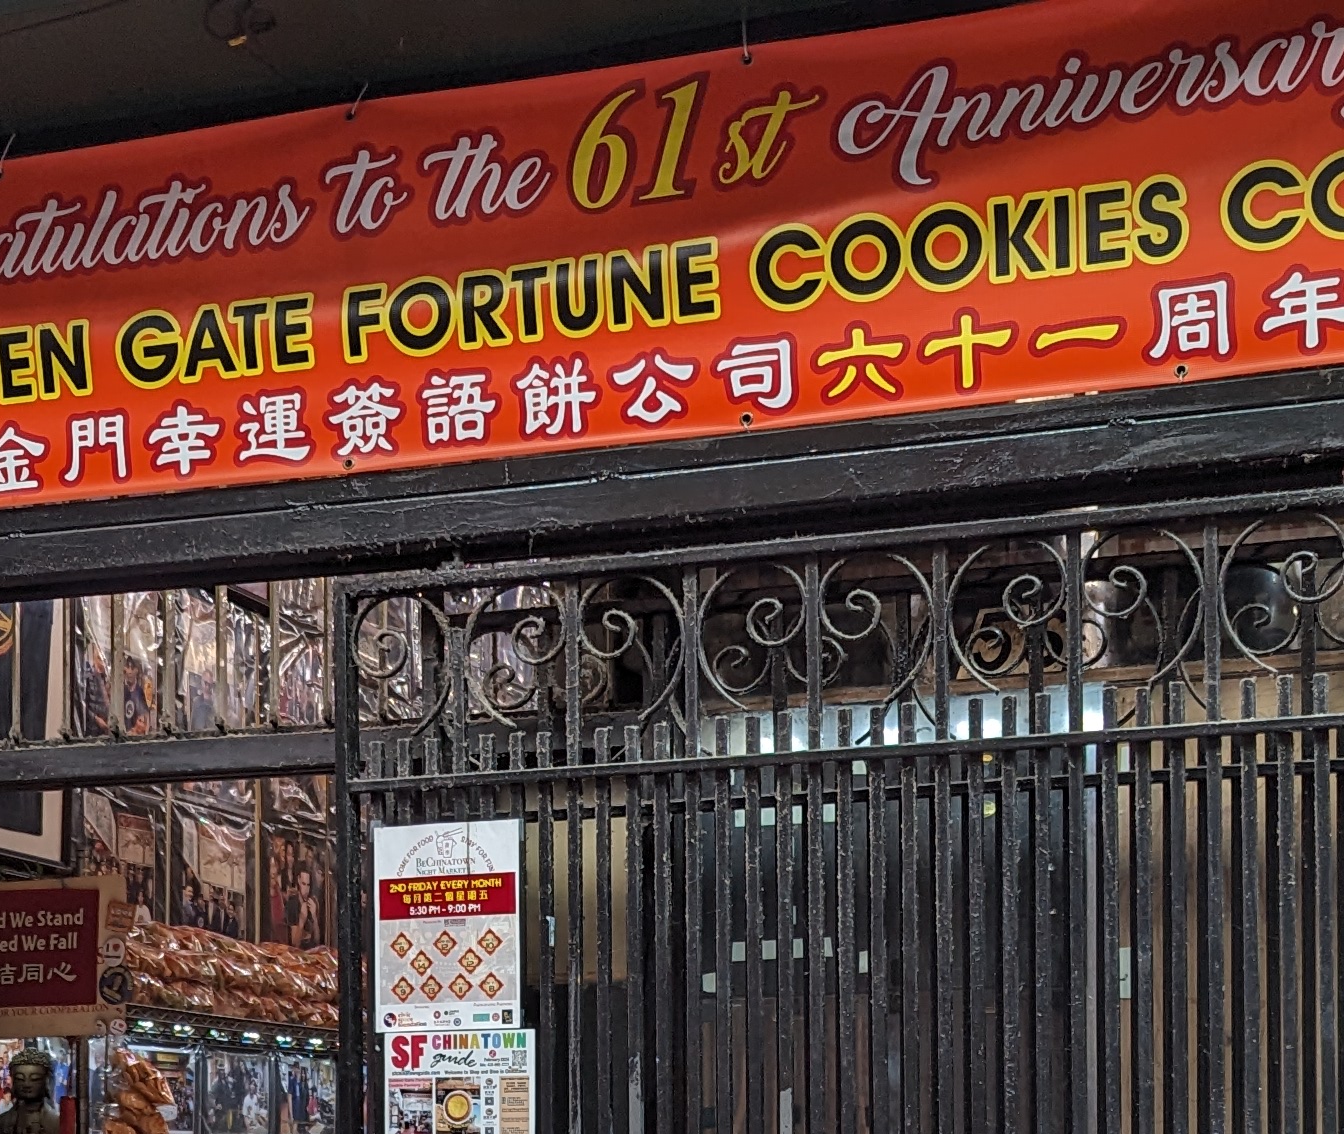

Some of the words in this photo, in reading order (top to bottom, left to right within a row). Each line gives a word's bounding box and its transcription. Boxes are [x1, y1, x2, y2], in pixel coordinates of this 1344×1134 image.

[325, 149, 408, 234] to
[423, 134, 551, 221] the
[572, 81, 699, 209] 61
[719, 90, 819, 184] st
[118, 296, 312, 385] GATE
[344, 239, 718, 361] FORTUNE
[754, 178, 1186, 309] COOKIES
[396, 856, 409, 877] COME
[406, 845, 418, 859] FOR
[417, 834, 434, 849] FOOD
[389, 882, 407, 893] 2ND
[407, 881, 439, 892] FRIDAY
[440, 879, 469, 891] EVERY
[471, 877, 502, 888] MONTH
[9, 910, 34, 929] We
[37, 907, 85, 927] Stand
[409, 905, 428, 916] 5:30
[428, 904, 441, 915] PM
[447, 904, 467, 914] 9:00
[468, 903, 482, 913] PM
[21, 934, 47, 951] We
[49, 931, 78, 951] Fall
[11, 1007, 39, 1018] YOUR
[39, 1003, 109, 1016] COOPERATION
[391, 1034, 428, 1070] SF
[431, 1032, 527, 1050] CHINATOWN
[430, 1050, 478, 1068] guide
